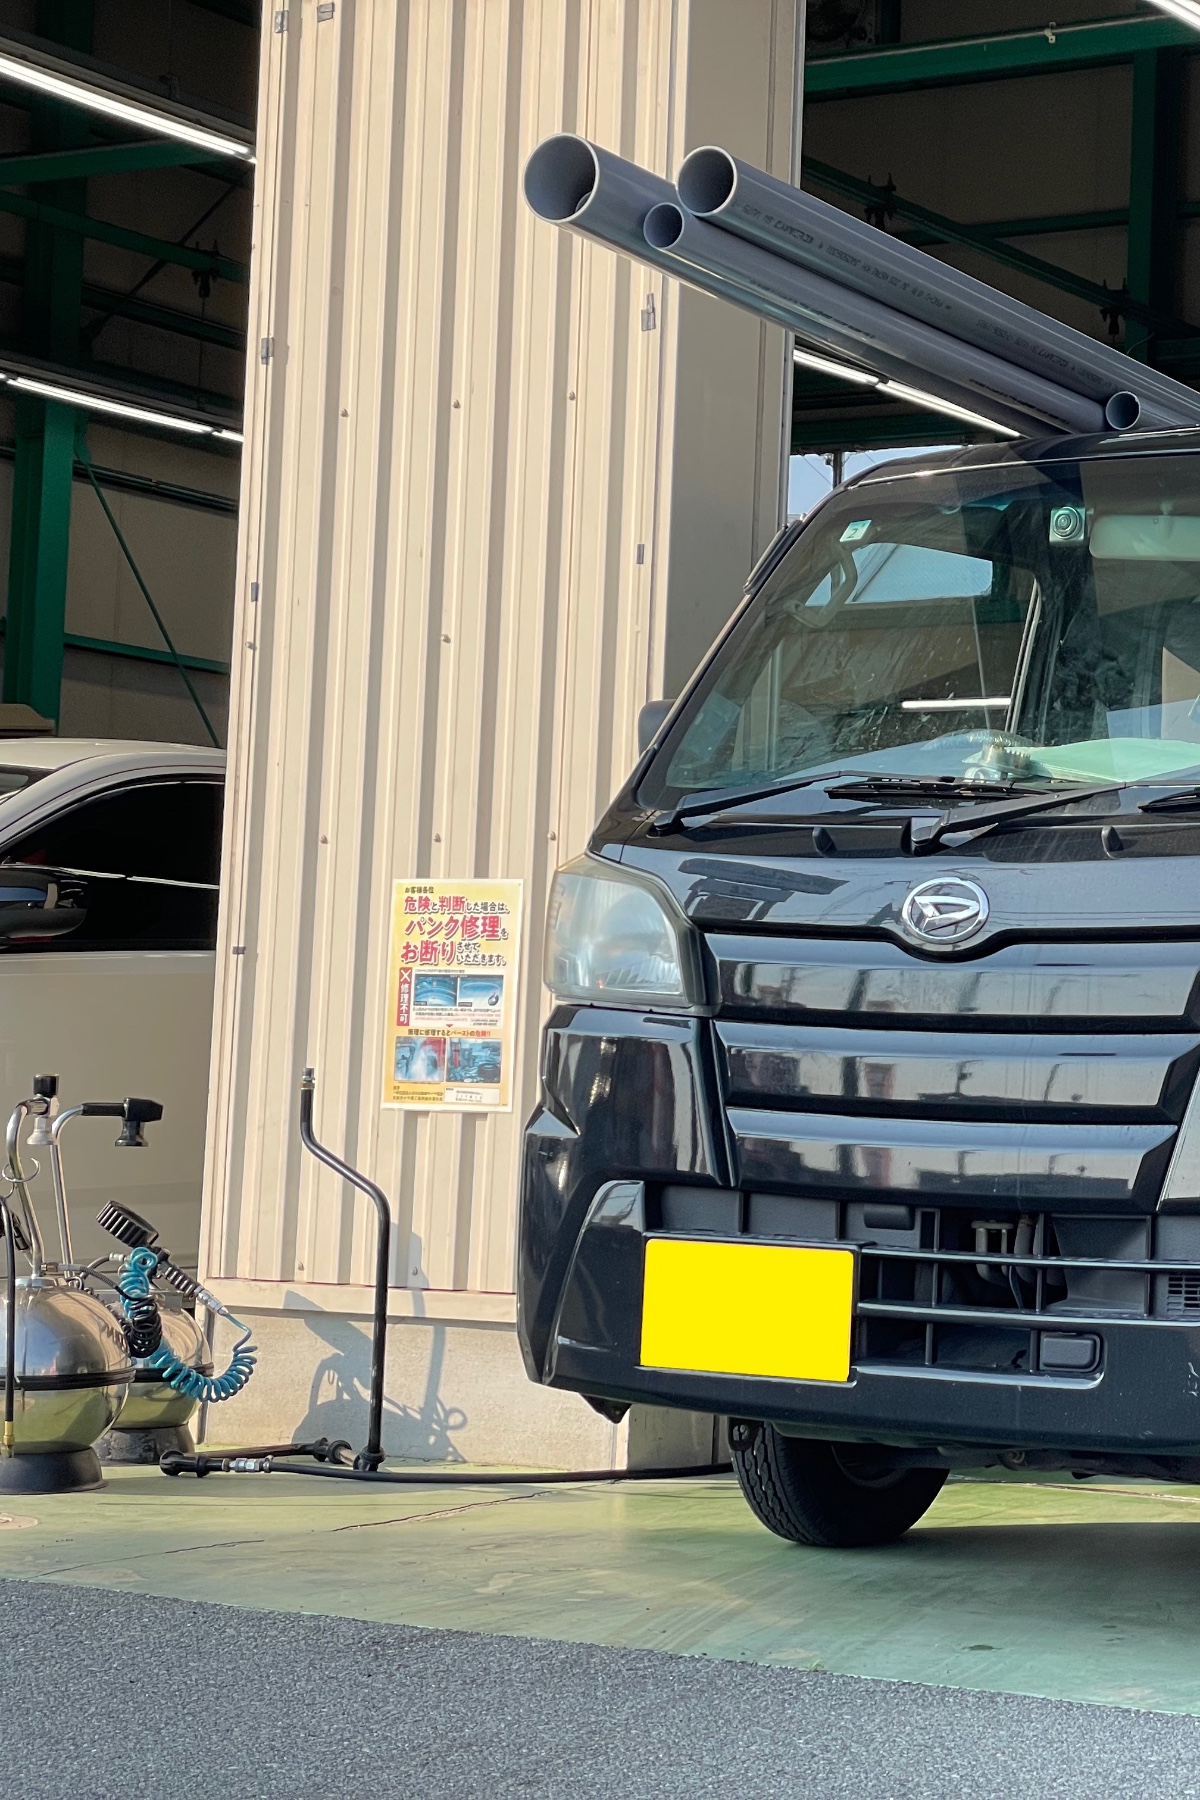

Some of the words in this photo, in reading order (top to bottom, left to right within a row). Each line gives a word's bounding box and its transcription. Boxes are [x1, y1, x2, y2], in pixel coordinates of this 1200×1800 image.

[846, 528, 859, 539] 2
[404, 895, 510, 914] 危険と判断した場合は、
[404, 914, 509, 941] パンク修理を
[400, 940, 457, 966] お断り
[457, 941, 481, 953] させて
[456, 953, 507, 967] いただきます。
[400, 983, 410, 1024] 修理不可
